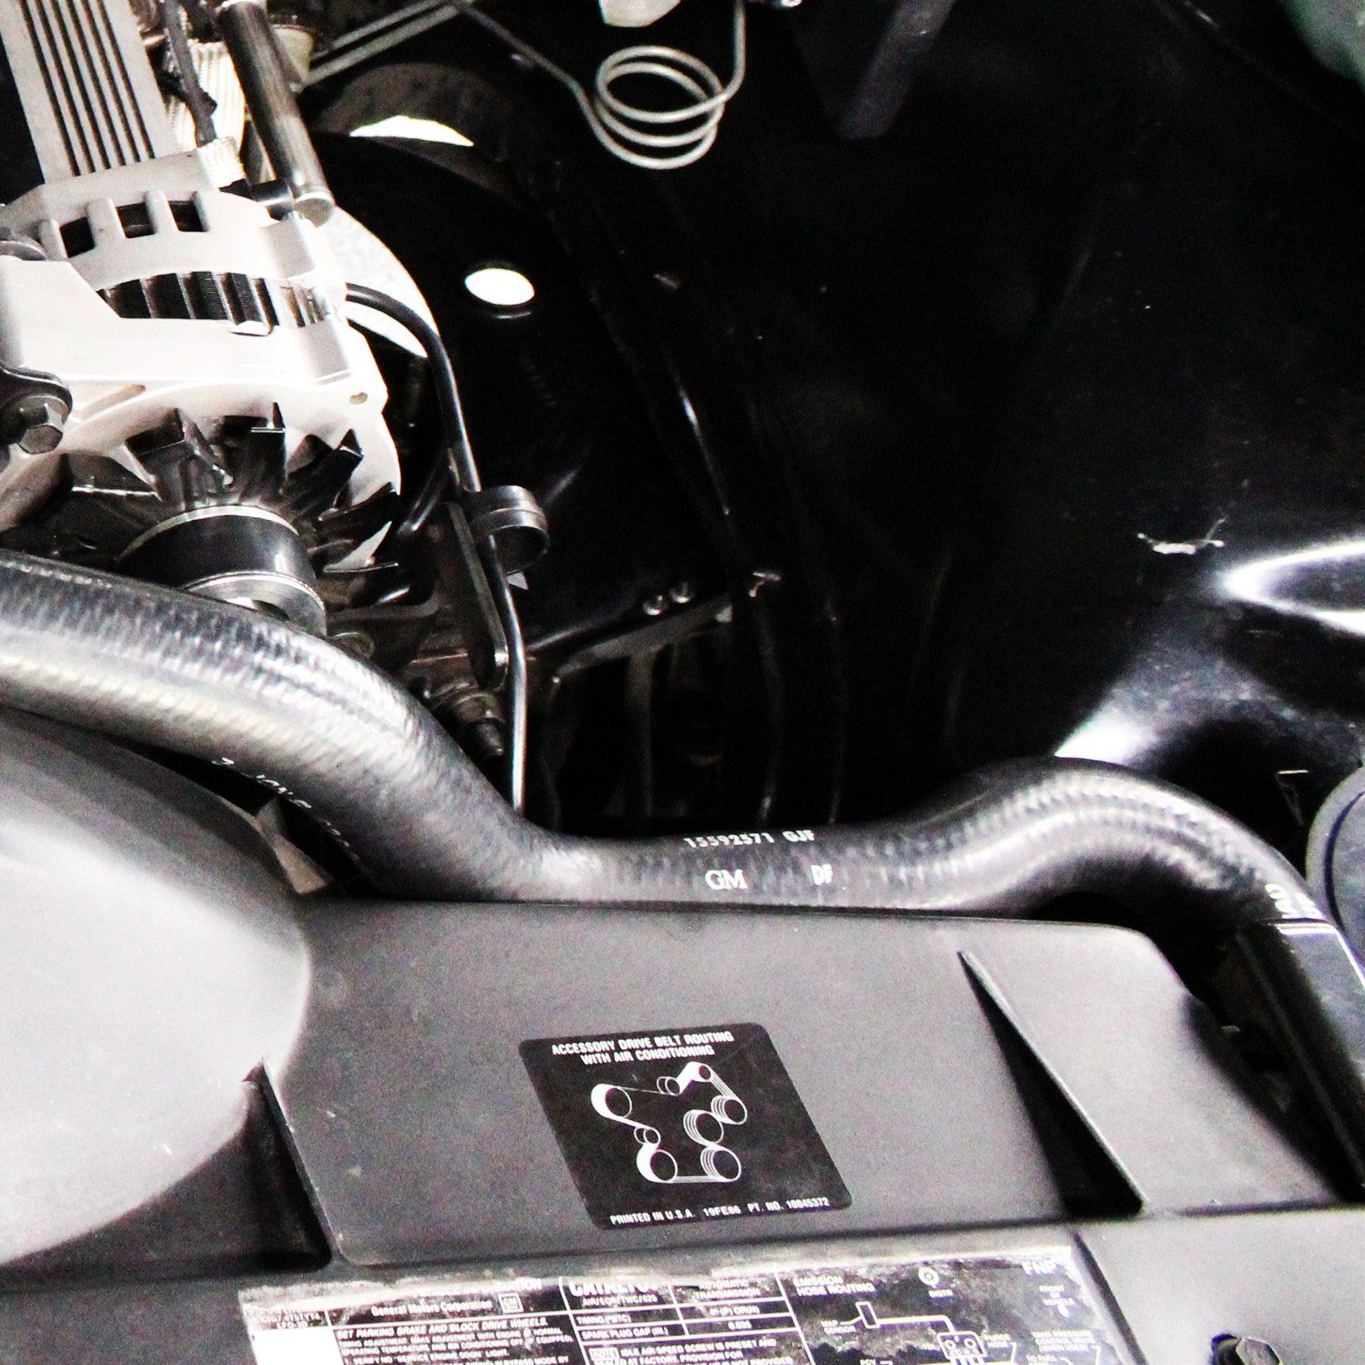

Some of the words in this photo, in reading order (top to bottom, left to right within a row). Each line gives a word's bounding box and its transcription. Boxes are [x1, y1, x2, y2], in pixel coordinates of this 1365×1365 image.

[705, 869, 748, 890] GM
[552, 1038, 615, 1055] ACCESSORY
[618, 1036, 653, 1051] DRIVE
[655, 1035, 682, 1048] BELT
[685, 1031, 735, 1046] ROUTING
[581, 1051, 612, 1065] WITH
[614, 1050, 634, 1063] AIR
[635, 1045, 715, 1061] CONDITIONING
[610, 1212, 651, 1225] PRINTED
[653, 1211, 664, 1222] IN
[667, 1208, 696, 1221] U.S.A.
[748, 1202, 765, 1213] PT.
[766, 1201, 784, 1212] NO.
[796, 1286, 828, 1296] HOSE
[828, 1283, 877, 1295] ROUTING
[370, 1305, 407, 1317] General
[408, 1302, 440, 1314] Motors
[440, 1299, 493, 1313] Corporation
[336, 1329, 354, 1339] SET
[356, 1327, 395, 1338] PARKING
[396, 1325, 427, 1336] BRAKE
[429, 1323, 449, 1334] AND
[449, 1322, 480, 1333] BLOCK
[481, 1320, 508, 1331] DRIVE
[581, 1330, 609, 1340] SPARK
[610, 1328, 633, 1338] PLUG
[633, 1327, 651, 1337] GAP
[431, 1343, 446, 1351] AND
[656, 1345, 684, 1354] SPEED
[684, 1343, 715, 1353] SCREW
[725, 1339, 757, 1349] PRESET
[759, 1338, 777, 1348] AND
[679, 1352, 725, 1363] PROVISION
[725, 1350, 744, 1360] FOR
